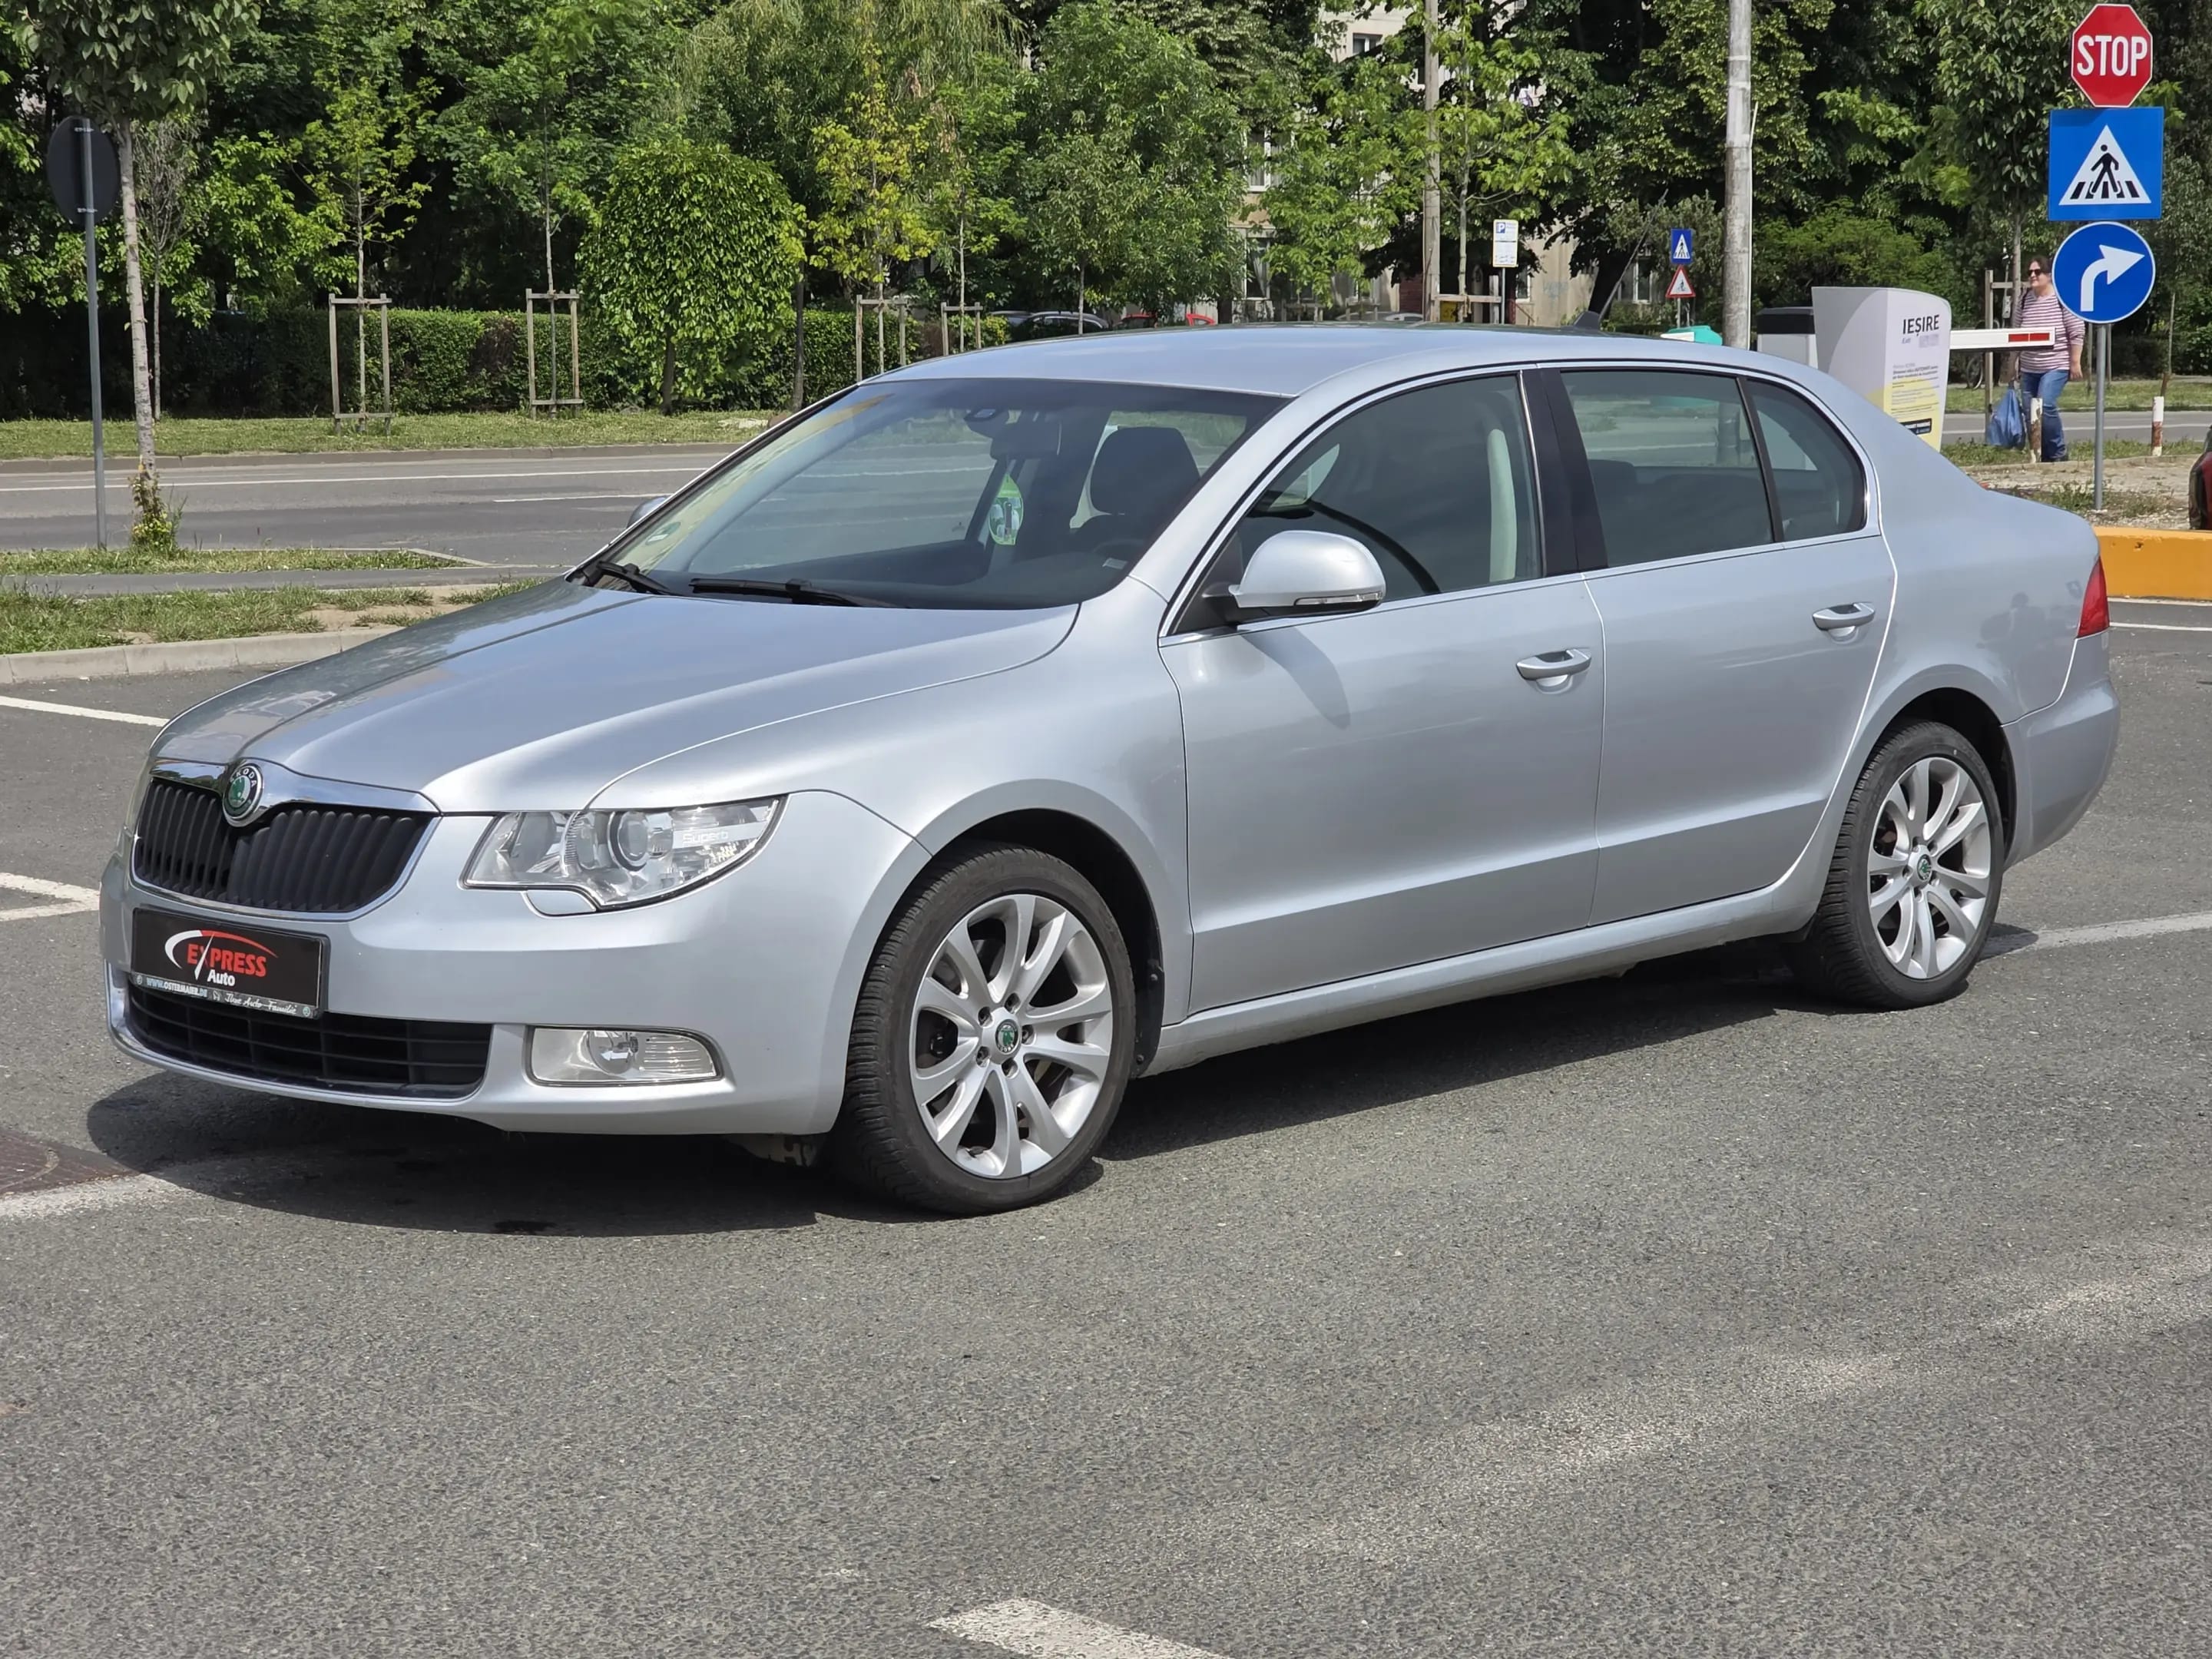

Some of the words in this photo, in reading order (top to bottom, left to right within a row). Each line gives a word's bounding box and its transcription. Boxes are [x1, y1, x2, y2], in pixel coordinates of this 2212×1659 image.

[2077, 35, 2147, 76] STOP
[187, 943, 267, 977] EXPRESS
[207, 969, 236, 986] Auto
